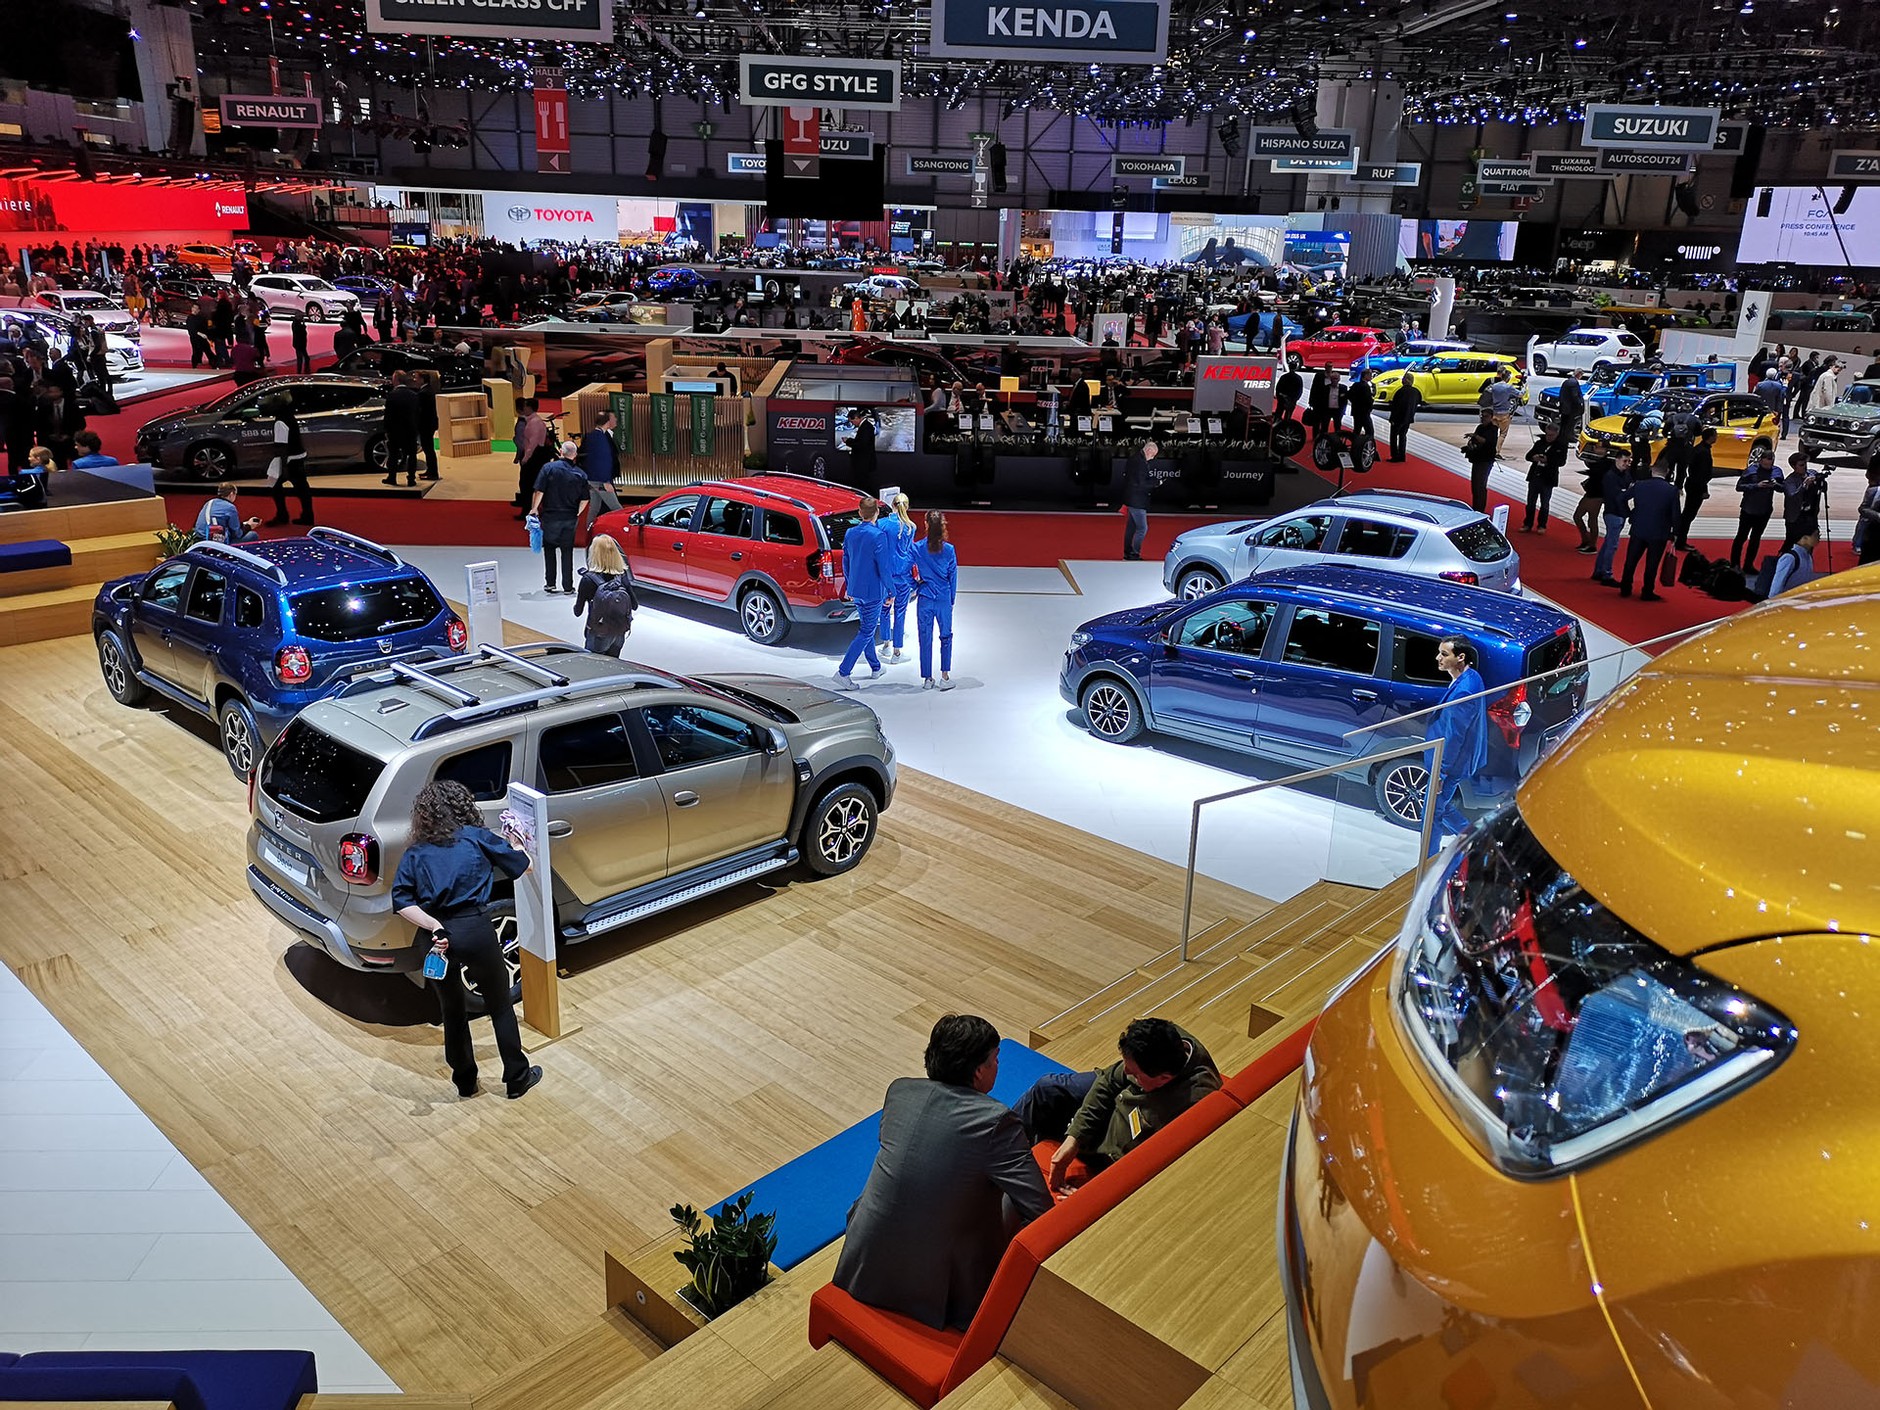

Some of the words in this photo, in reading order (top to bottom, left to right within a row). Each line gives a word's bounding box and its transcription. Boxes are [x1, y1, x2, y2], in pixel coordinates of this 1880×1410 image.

[987, 6, 1117, 40] KENDA
[535, 67, 564, 77] HALLE
[546, 77, 554, 89] 3
[764, 72, 808, 91] GFG
[813, 73, 878, 94] STYLE
[236, 104, 307, 119] RENAULT
[1613, 118, 1688, 136] SUZUKI
[1260, 138, 1310, 149] HISPANO
[1312, 140, 1346, 150] SUIZA
[740, 158, 767, 168] TOYO
[914, 160, 969, 170] SSANGYONG
[1560, 158, 1591, 166] LUXARIA
[1608, 153, 1682, 166] AUTOSCOUT24
[1121, 162, 1176, 172] YOKOHAMA
[1371, 168, 1396, 179] RUF
[1168, 176, 1198, 185] LEXUS
[1500, 183, 1521, 192] FIAT
[0, 197, 32, 211] iere
[221, 205, 245, 215] RENAULT
[534, 208, 594, 223] TOYOTA
[1203, 364, 1273, 381] KENDA
[1243, 380, 1272, 389] TIRES
[776, 416, 826, 430] KENDA
[241, 429, 259, 438] SBB
[1223, 470, 1264, 480] Journey
